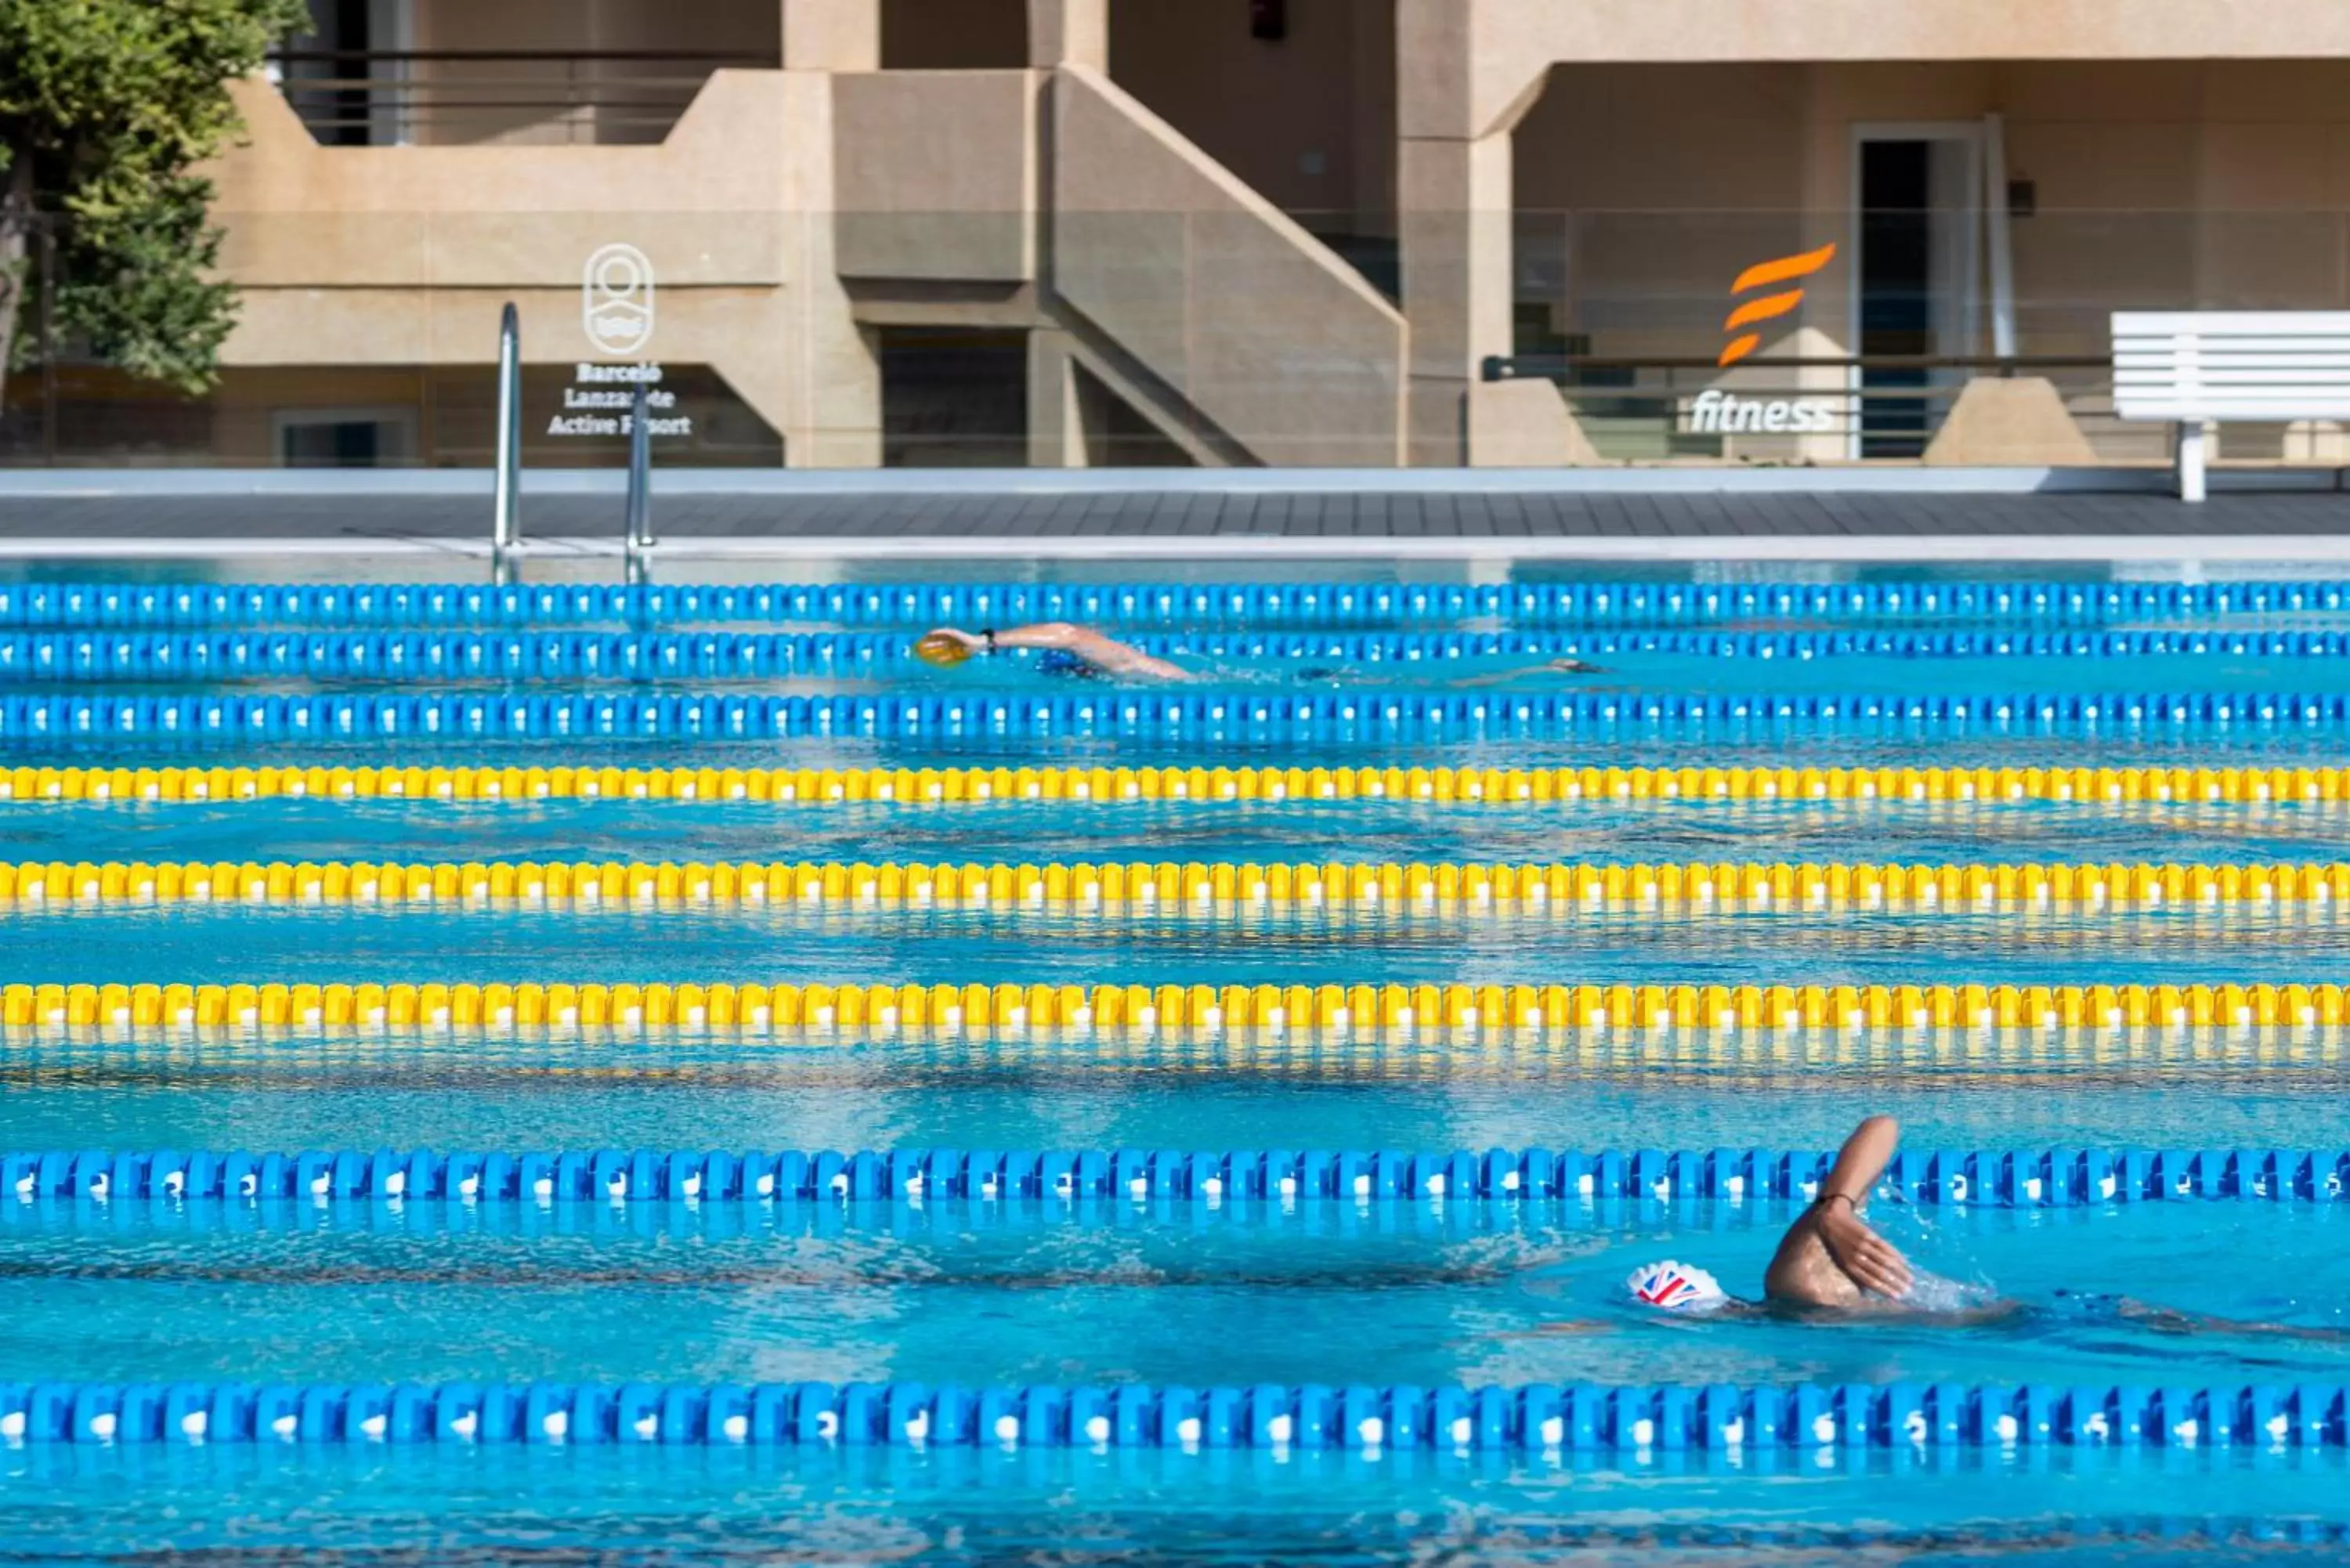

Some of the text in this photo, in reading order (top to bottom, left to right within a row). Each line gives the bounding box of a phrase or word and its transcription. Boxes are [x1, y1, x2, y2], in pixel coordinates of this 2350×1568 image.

[548, 414, 692, 435] Active Rsort
[1691, 389, 1837, 432] fitness
